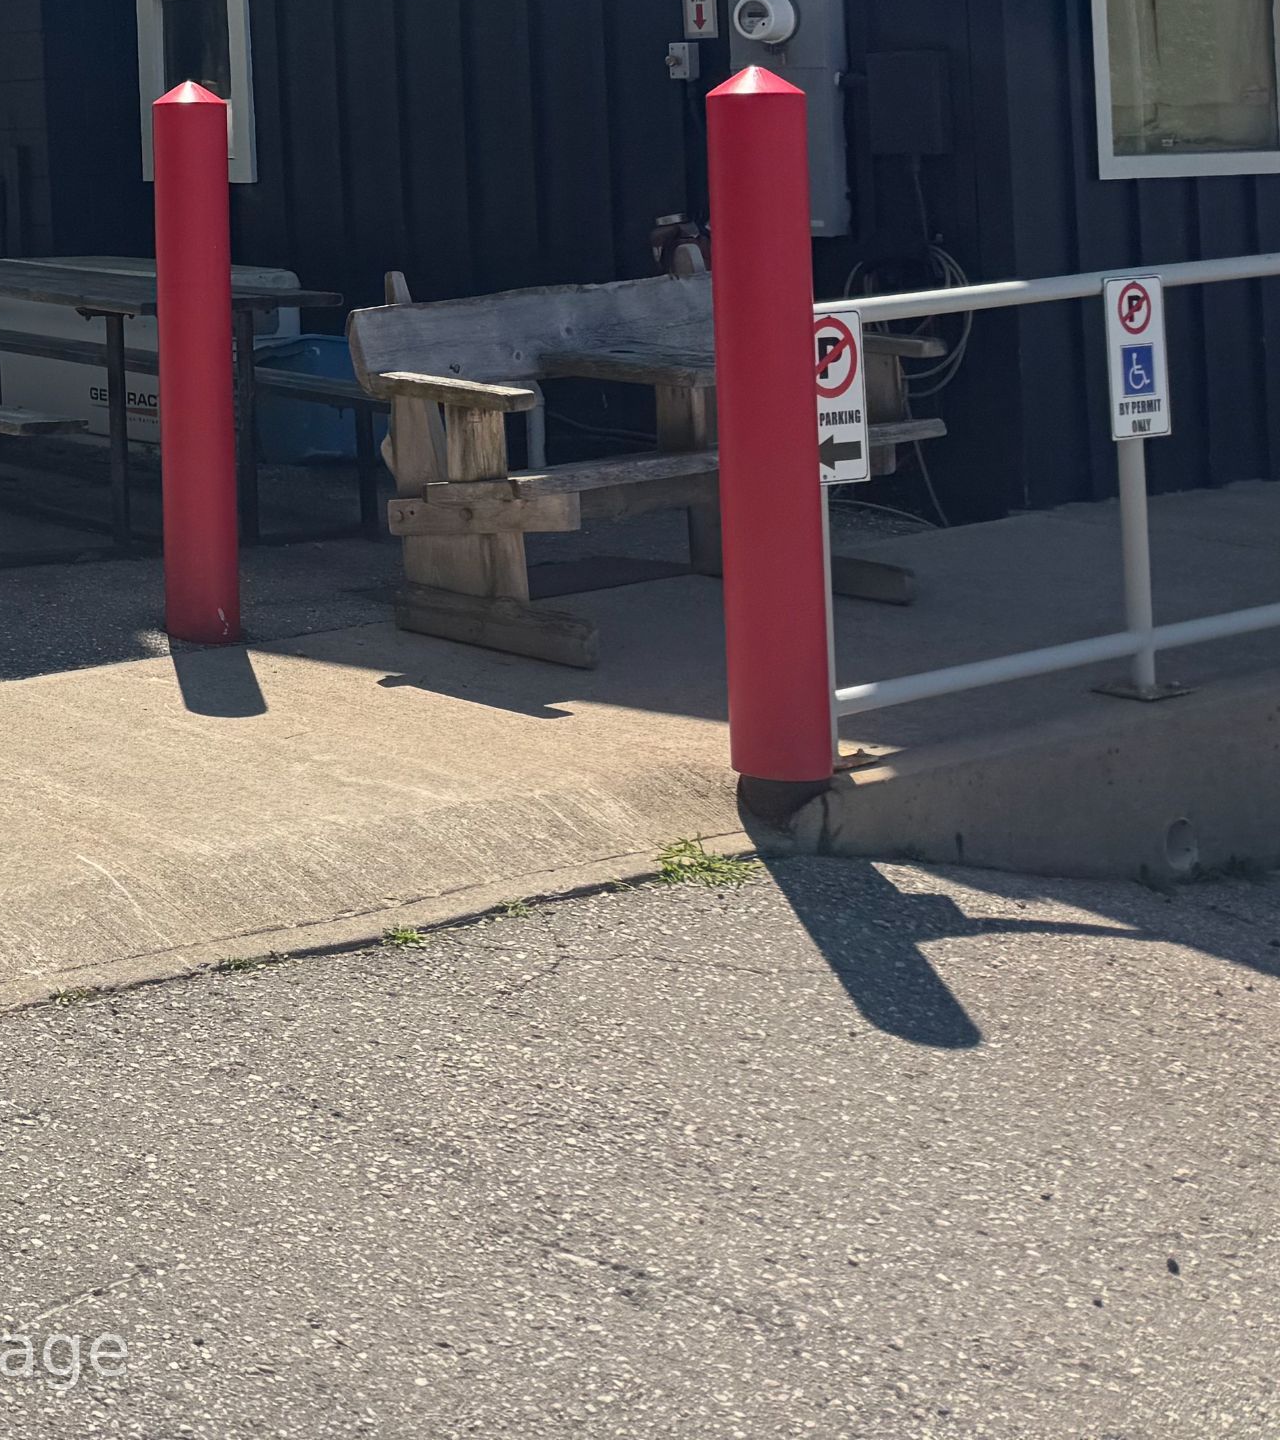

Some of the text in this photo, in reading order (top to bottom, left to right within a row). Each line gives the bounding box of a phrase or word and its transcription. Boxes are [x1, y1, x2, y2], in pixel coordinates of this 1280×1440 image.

[89, 387, 158, 408] GERAC
[1119, 398, 1161, 416] BY PERMIT
[819, 409, 861, 426] PARKING
[1132, 418, 1151, 433] ONLY
